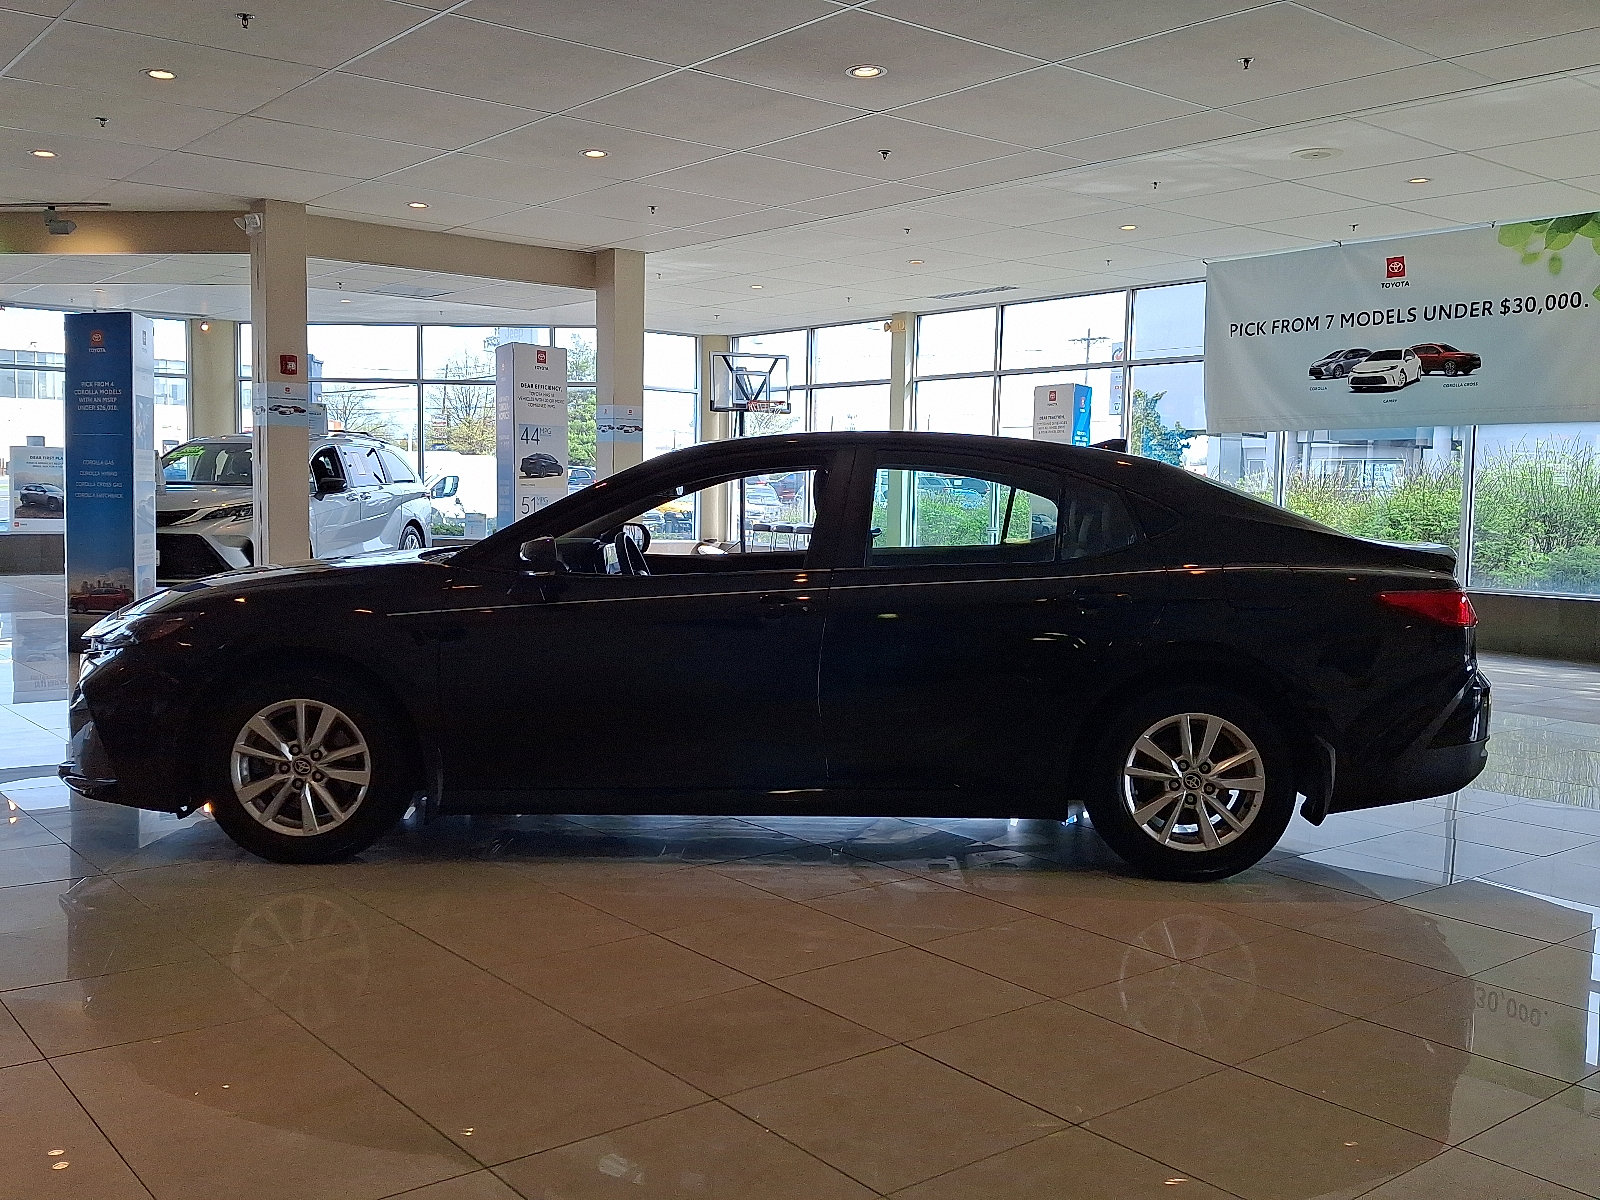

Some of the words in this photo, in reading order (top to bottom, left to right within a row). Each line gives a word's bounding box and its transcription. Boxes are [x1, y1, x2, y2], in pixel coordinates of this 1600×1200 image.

[1230, 321, 1267, 337] PICK
[1271, 315, 1320, 334] FROM
[1326, 315, 1334, 330] 7
[1340, 307, 1417, 329] MODELS
[1423, 300, 1493, 321] UNDER
[1499, 291, 1589, 316] $30,000.
[520, 427, 540, 445] 44
[521, 496, 537, 515] 51
